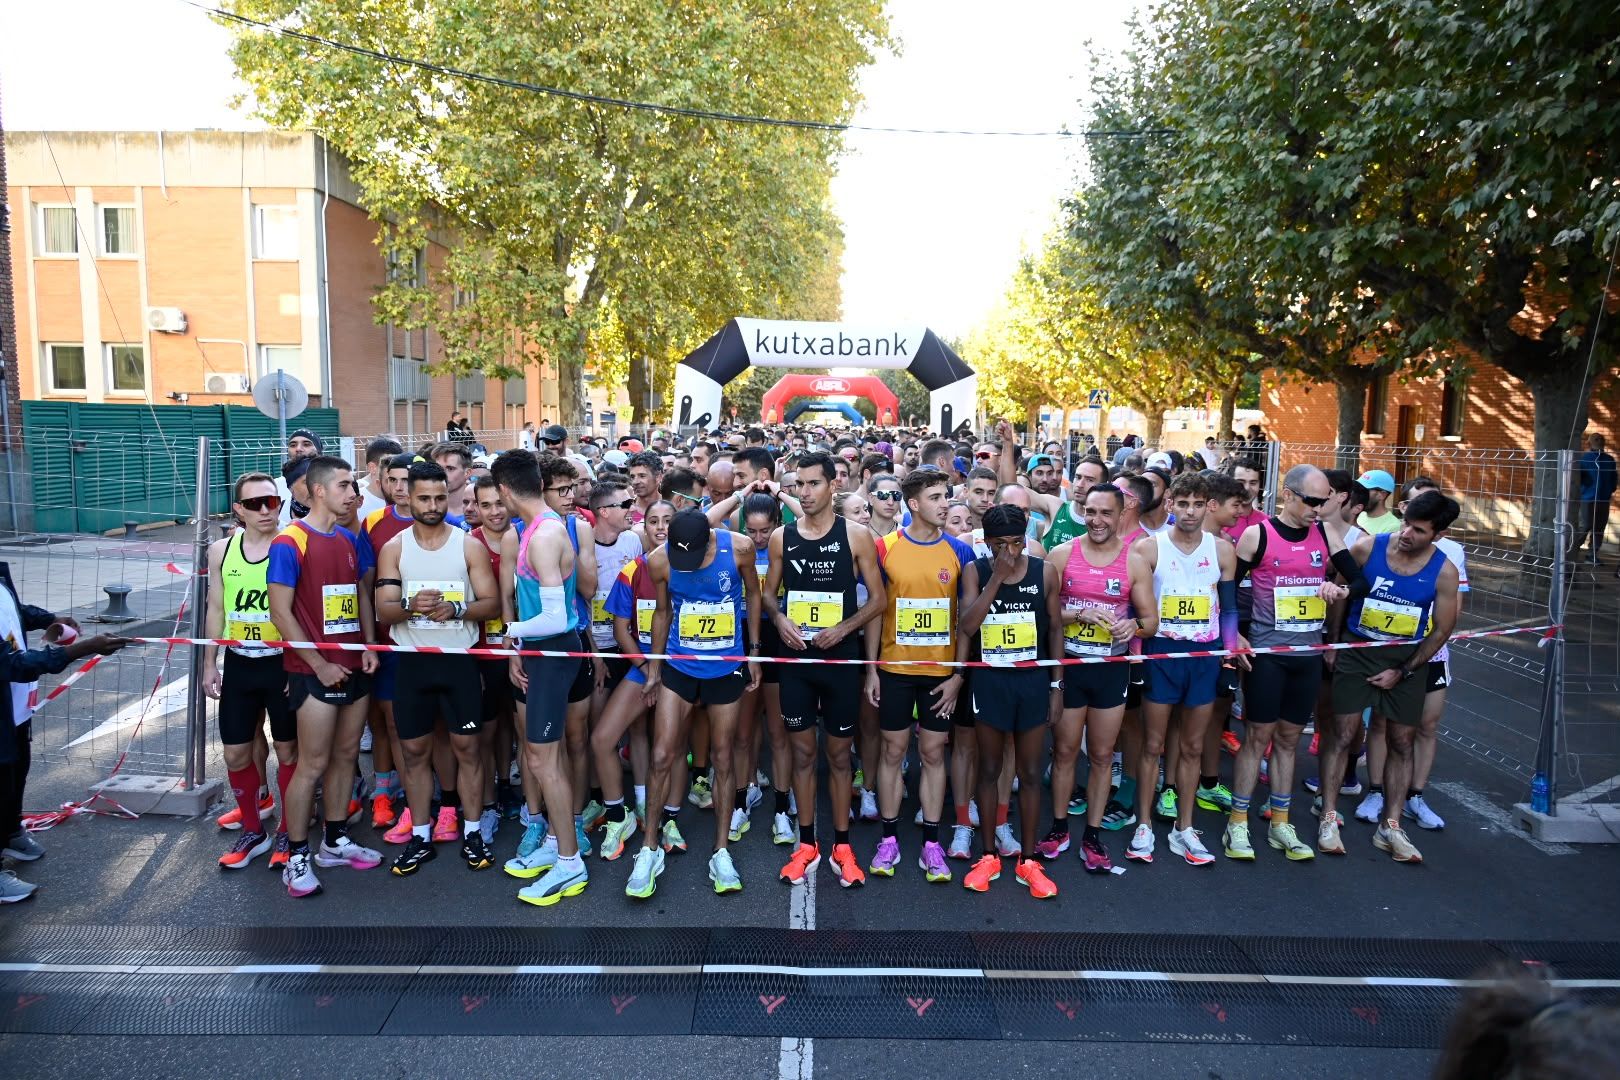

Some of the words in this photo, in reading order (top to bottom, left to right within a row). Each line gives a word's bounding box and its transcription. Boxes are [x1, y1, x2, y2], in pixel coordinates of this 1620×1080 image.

[755, 329, 907, 356] kutxabank
[808, 561, 836, 569] VICKY
[341, 598, 354, 614] 48
[810, 606, 819, 622] 6
[1004, 602, 1031, 610] VICKY
[1178, 600, 1196, 615] 84
[1298, 600, 1307, 615] 5
[698, 618, 716, 634] 72
[914, 612, 932, 629] 30
[1384, 615, 1395, 629] 7
[243, 626, 261, 641] 26
[1002, 628, 1016, 644] 15
[1079, 622, 1095, 638] 25
